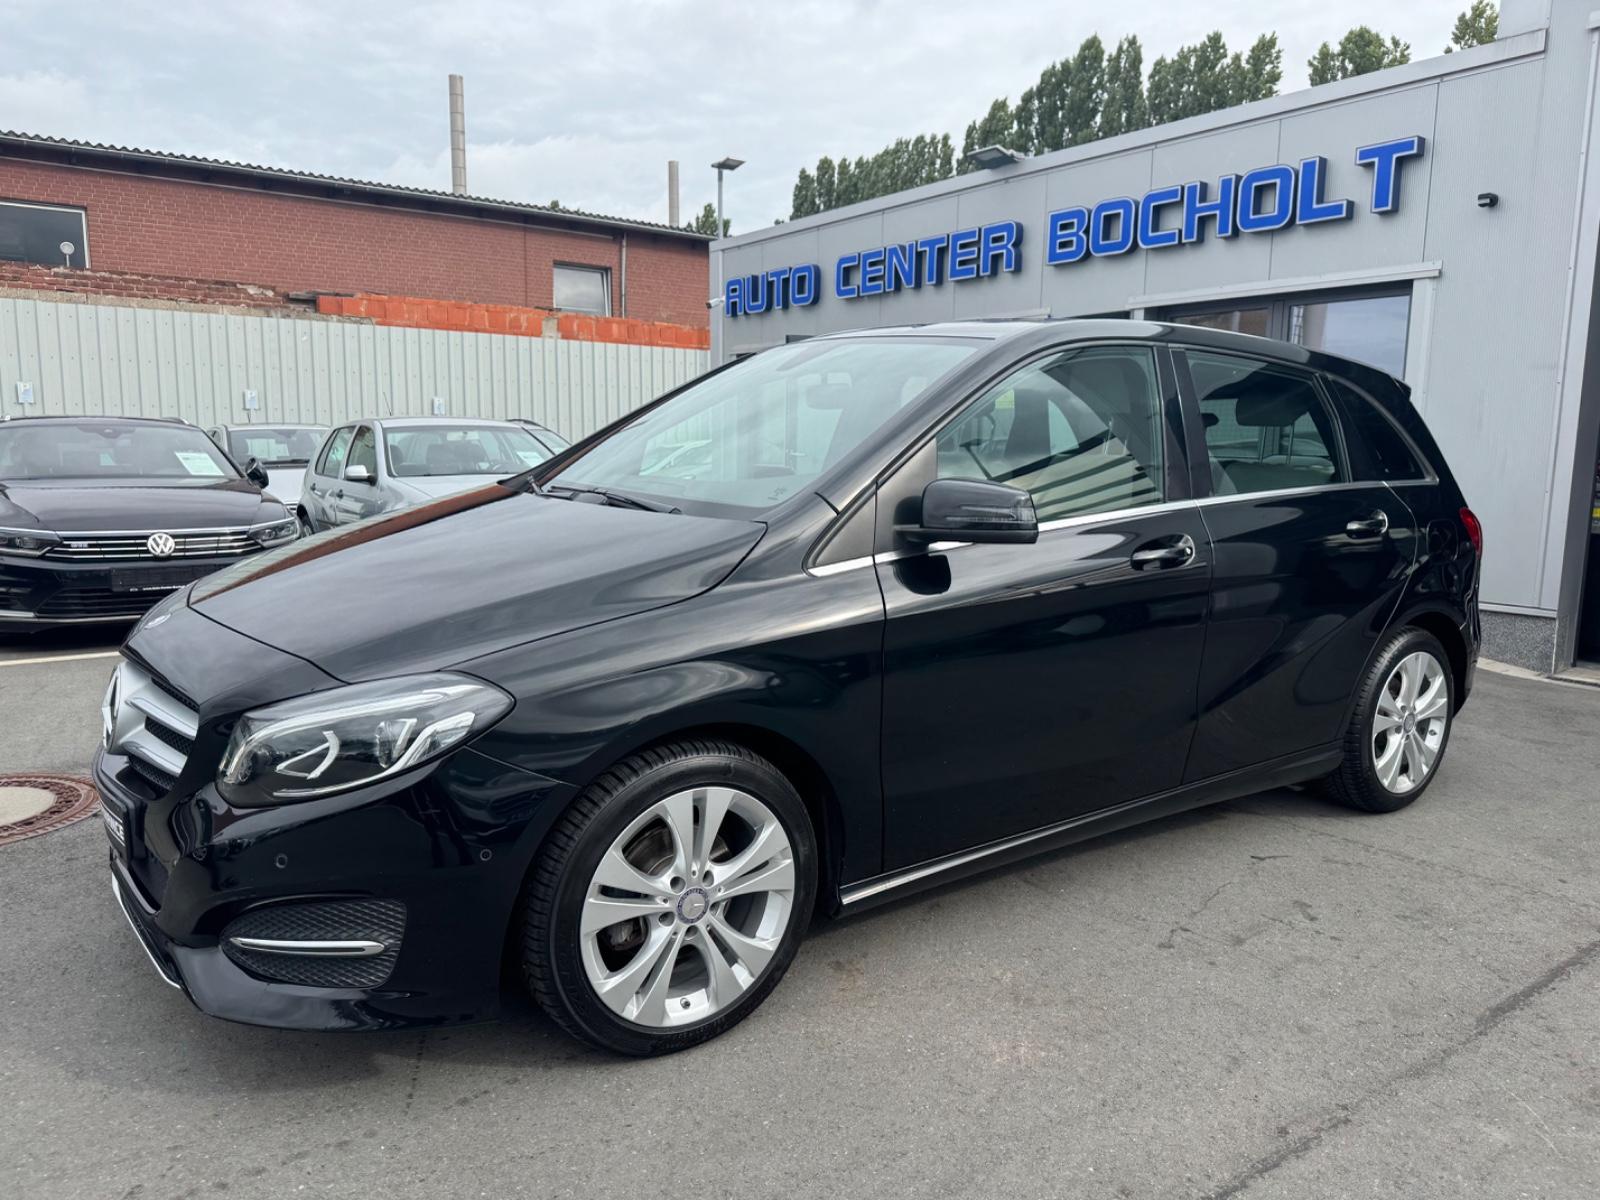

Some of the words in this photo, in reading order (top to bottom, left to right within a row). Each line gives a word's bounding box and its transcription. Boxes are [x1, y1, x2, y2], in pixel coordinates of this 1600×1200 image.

[725, 263, 820, 318] AUTO
[835, 221, 1022, 300] CENTER
[1047, 136, 1423, 266] BOCHOLT
[147, 532, 175, 556] VW
